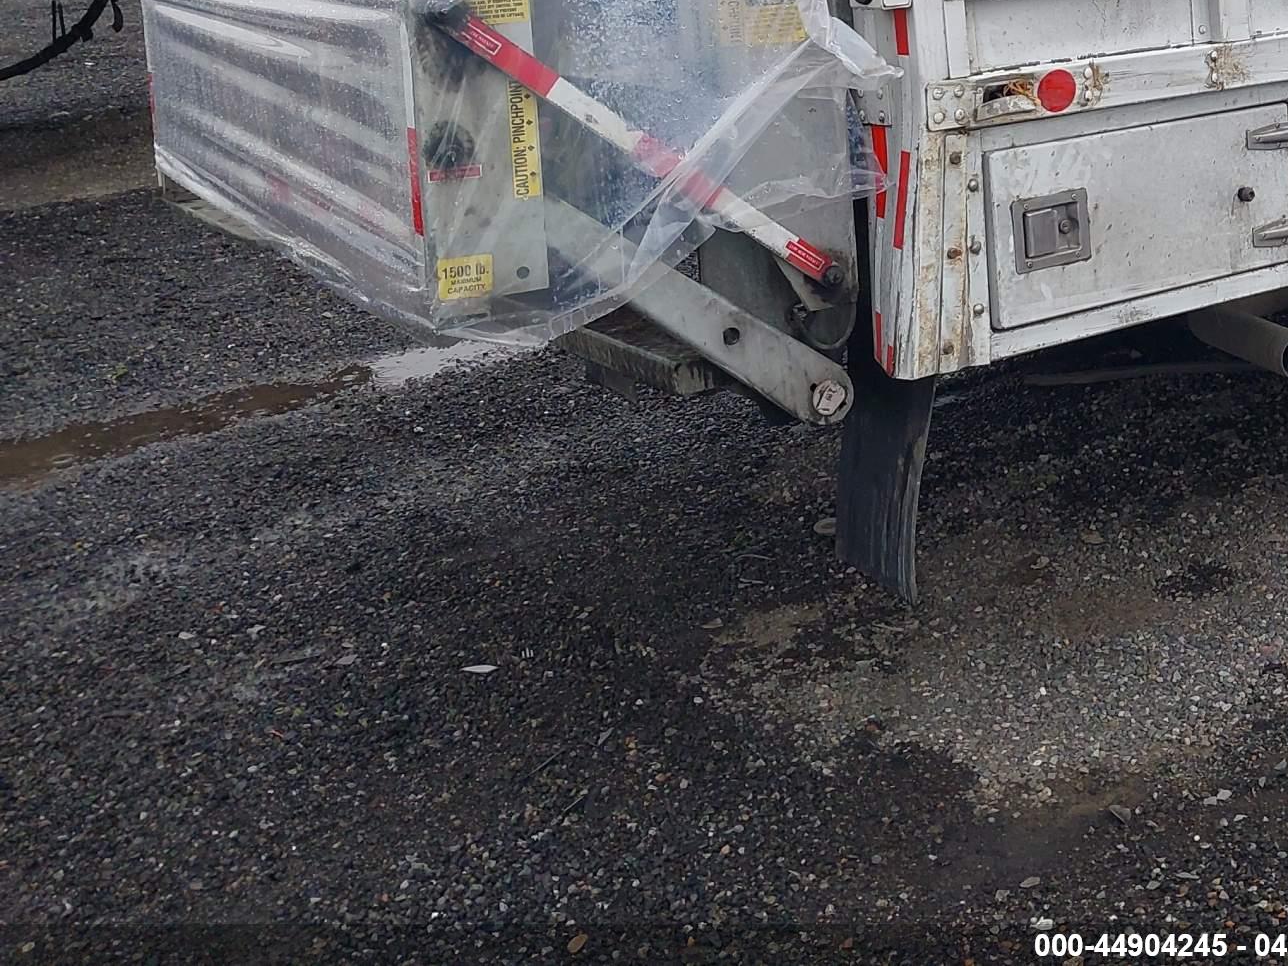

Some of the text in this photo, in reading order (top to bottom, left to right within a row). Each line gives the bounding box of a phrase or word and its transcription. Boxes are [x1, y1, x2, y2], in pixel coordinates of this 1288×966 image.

[513, 146, 530, 197] CAUTION:
[441, 262, 489, 280] 1500 lb.
[450, 276, 481, 285] MAXIMUM
[447, 282, 487, 295] CAPACITY
